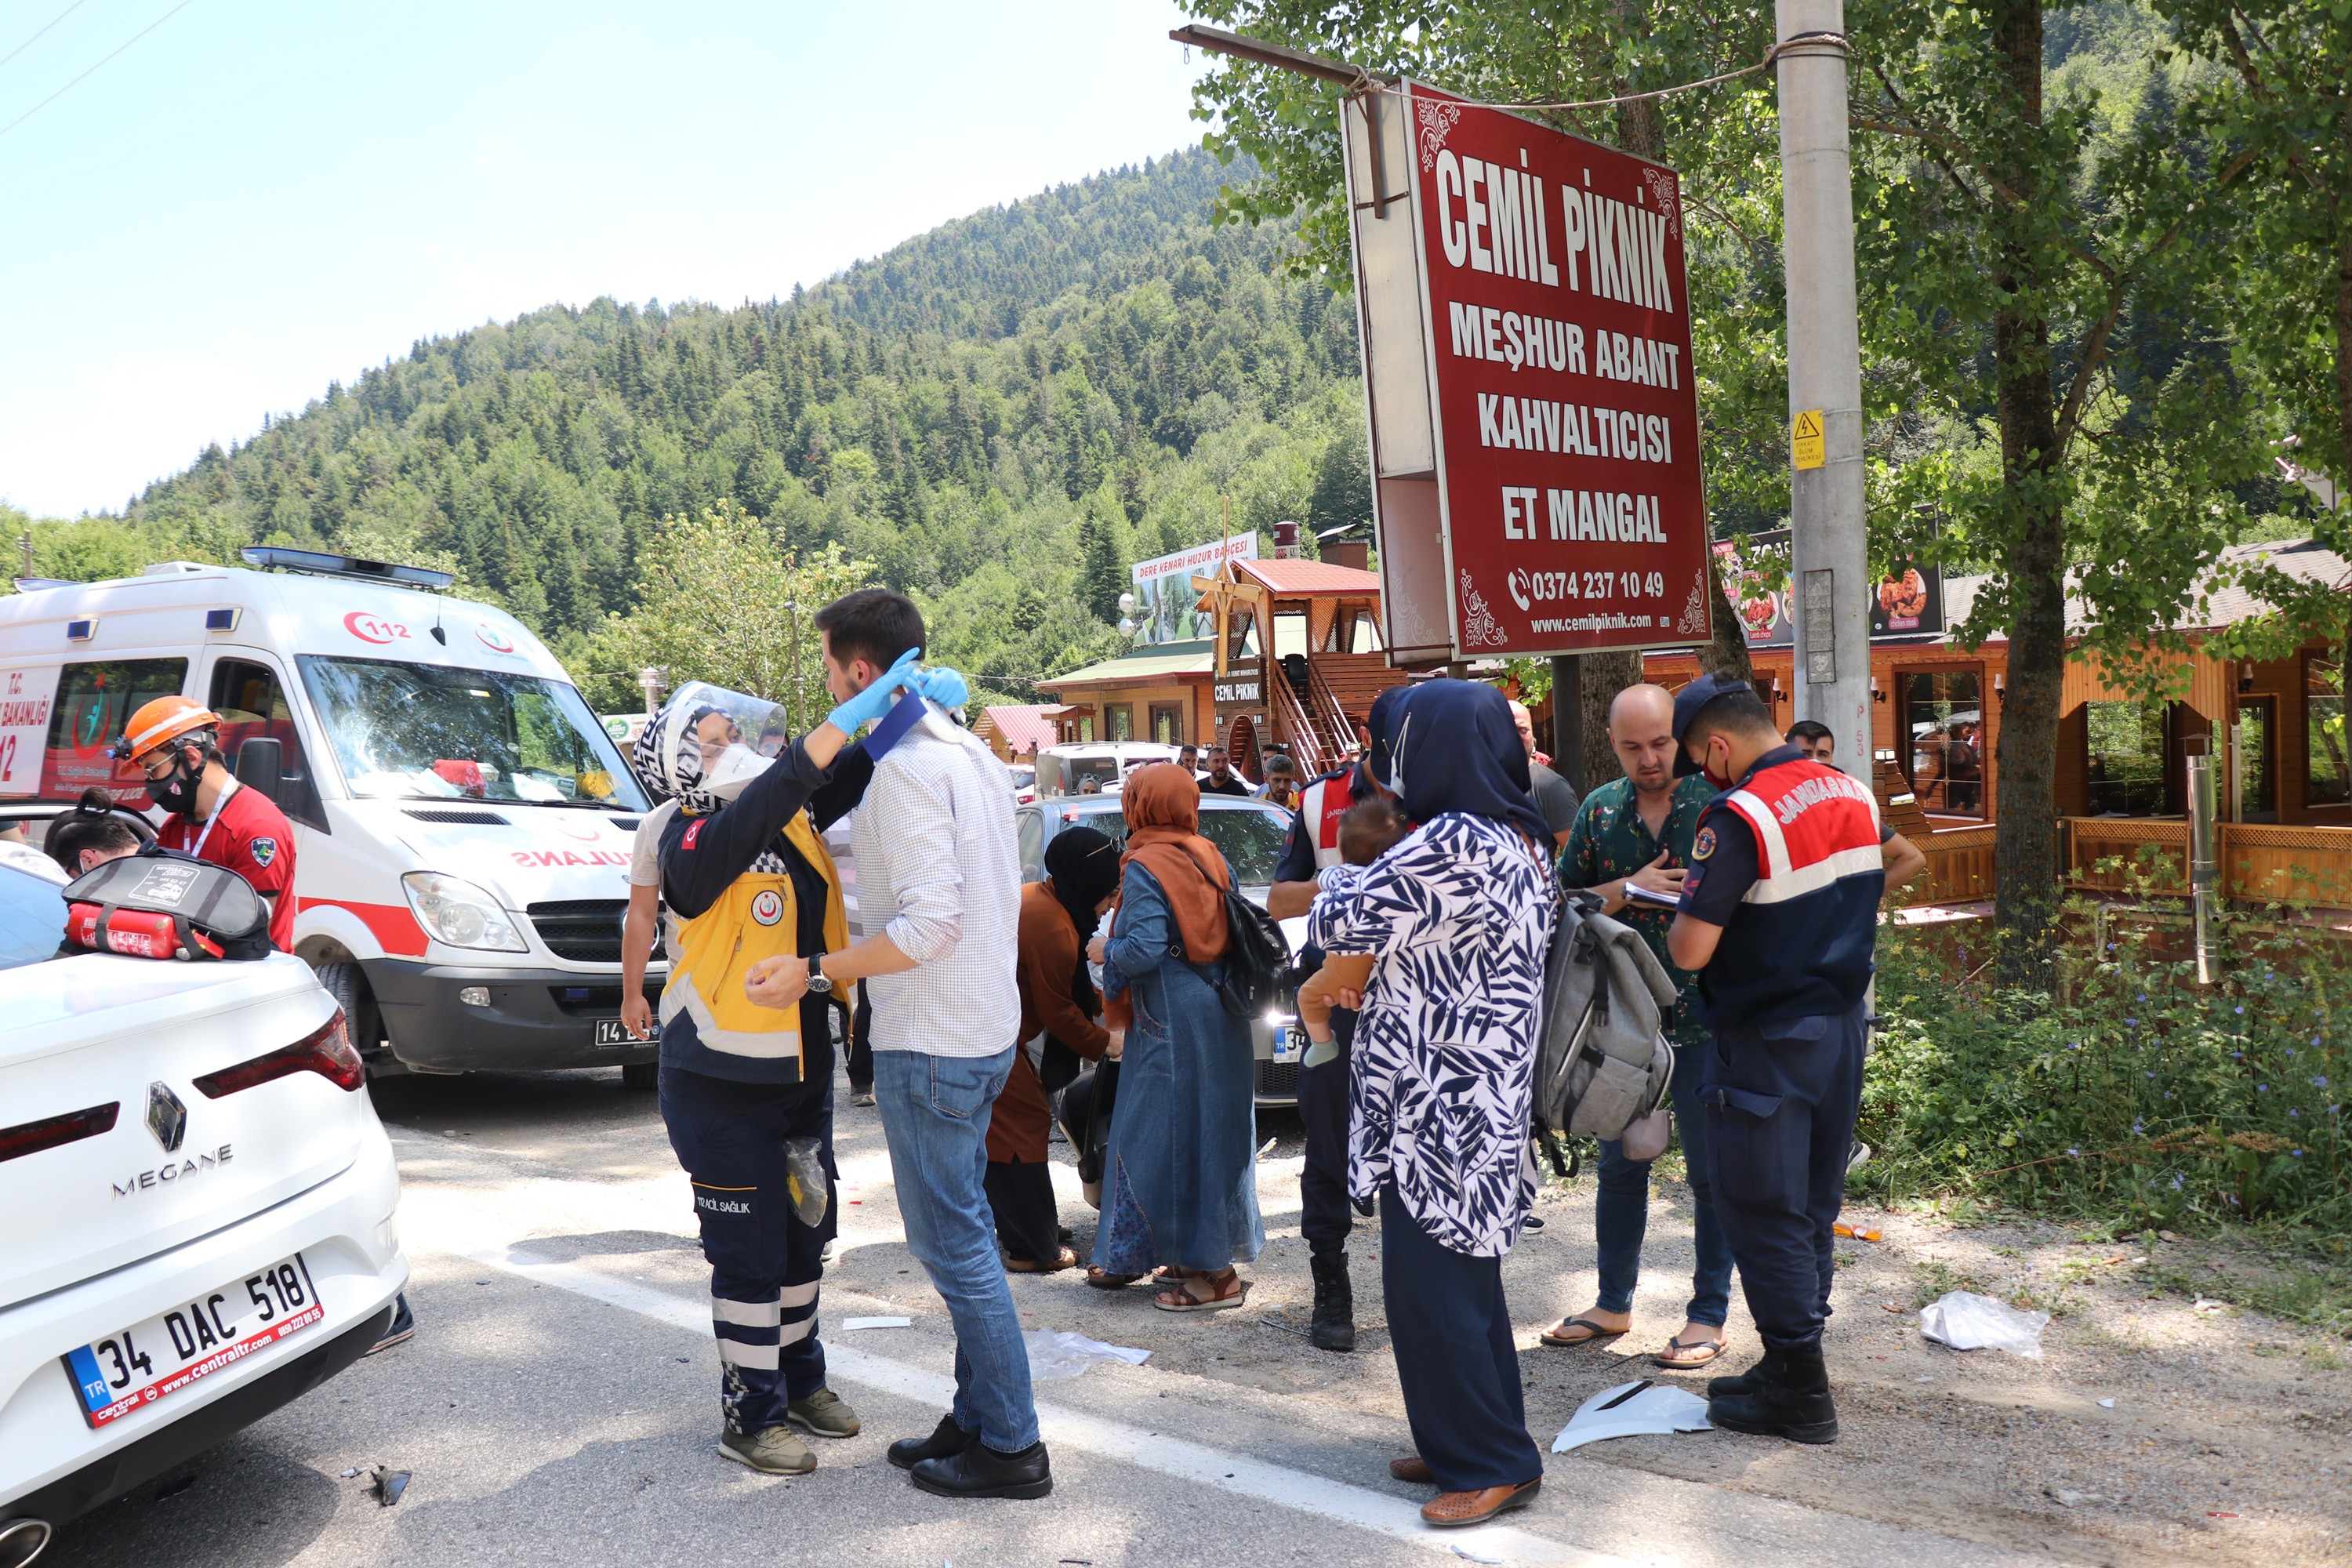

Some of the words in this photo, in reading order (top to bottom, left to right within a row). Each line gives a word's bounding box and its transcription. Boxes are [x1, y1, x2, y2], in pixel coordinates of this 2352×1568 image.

[1436, 147, 1559, 287] CEMİL
[1562, 167, 1673, 314] PİKNİK
[1449, 301, 1588, 375] MEŞHUR
[1595, 329, 1679, 390] ABANT
[1477, 393, 1671, 463] KAHVALTICISI
[1501, 486, 1537, 540] ET
[1547, 488, 1667, 543] MANGAL
[1140, 564, 1157, 578] DERE
[1159, 557, 1185, 573] KENARI
[1187, 550, 1212, 564] HUZUR
[1214, 536, 1248, 560] BAHÇESİ
[1532, 572, 1579, 601] 0374
[1583, 572, 1614, 599] 237
[1620, 572, 1640, 598] 10
[1644, 572, 1664, 598] 49
[365, 621, 412, 639] 112
[1531, 612, 1652, 634] www.cemilpiknik.com
[1760, 630, 1772, 639] chops
[1890, 619, 1905, 628] chicken
[1906, 617, 1917, 626] steak
[8, 673, 23, 695] T.C.
[1, 695, 49, 727] BAKANLIĞI
[1327, 808, 1347, 819] JANDA
[1774, 776, 1867, 824] JANDARMA
[601, 1023, 620, 1042] 14
[110, 1143, 234, 1200] MEGANE
[706, 1197, 719, 1211] ACİL
[720, 1201, 750, 1214] SAĞLIK
[85, 1380, 107, 1399] TR
[97, 1331, 153, 1389] 34
[164, 1294, 236, 1360] DAC
[245, 1263, 304, 1321] 518
[97, 1394, 140, 1421] central
[162, 1333, 273, 1394] www.centraltr.com
[278, 1323, 292, 1338] 0850
[291, 1316, 303, 1331] 222
[303, 1312, 312, 1325] 80
[313, 1307, 321, 1319] 55
